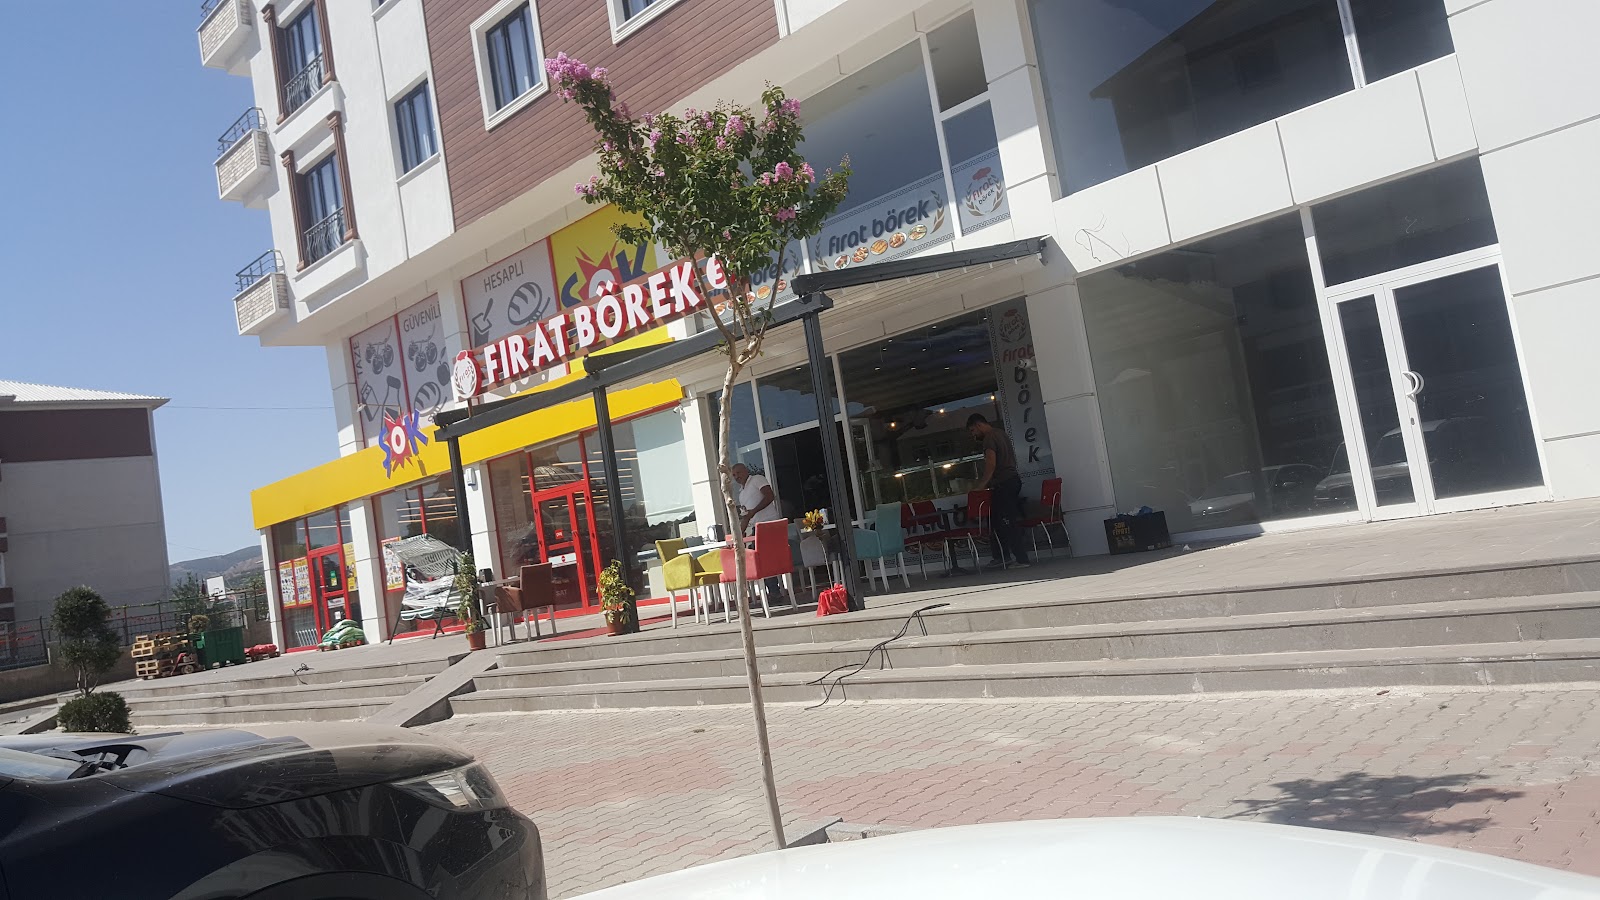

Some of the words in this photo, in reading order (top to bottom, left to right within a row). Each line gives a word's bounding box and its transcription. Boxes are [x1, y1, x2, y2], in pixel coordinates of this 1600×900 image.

[828, 224, 868, 257] fırat
[872, 199, 930, 238] börek
[483, 260, 524, 292] HESAPLI
[482, 313, 568, 385] FIRAT
[574, 261, 702, 348] BÖREK
[353, 340, 363, 379] TAZE
